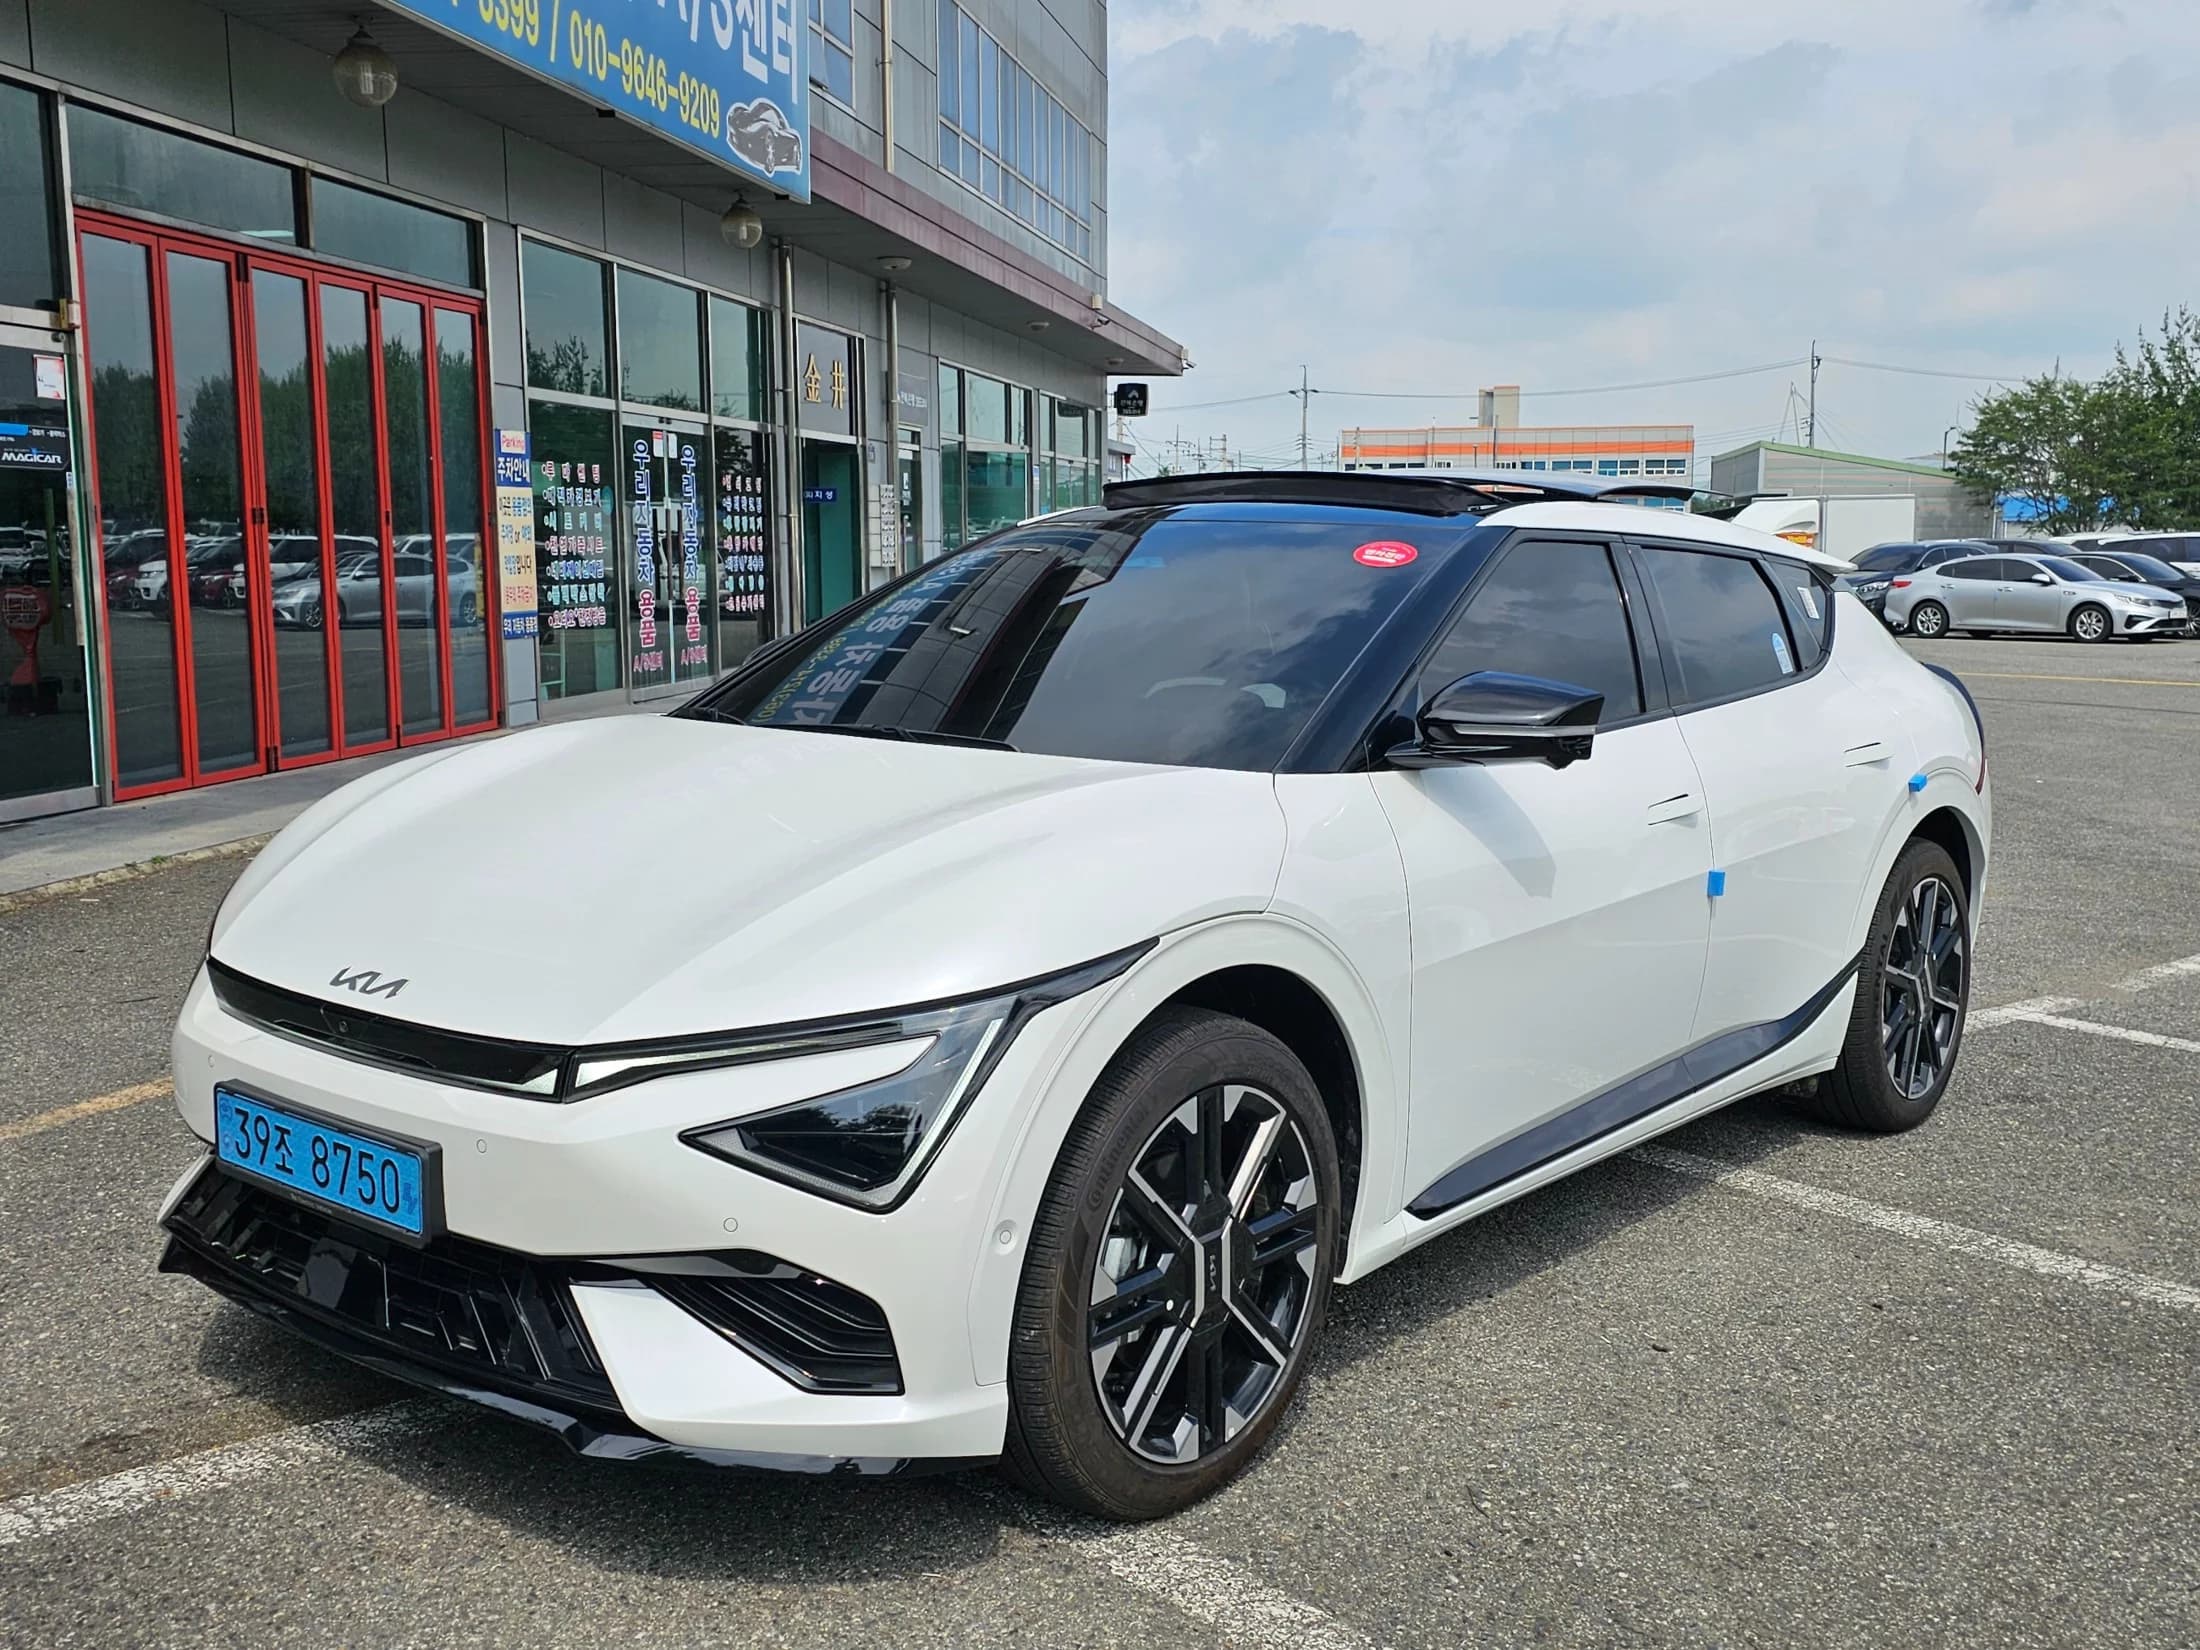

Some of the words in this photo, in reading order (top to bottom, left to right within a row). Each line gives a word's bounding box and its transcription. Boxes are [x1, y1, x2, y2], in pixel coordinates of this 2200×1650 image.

[569, 10, 720, 138] 010-9646-9209
[803, 353, 846, 410] 金井
[2, 451, 63, 464] MAGICAR
[497, 456, 531, 483] 주차안내
[234, 1107, 294, 1176] 39조
[311, 1135, 401, 1214] 8750
